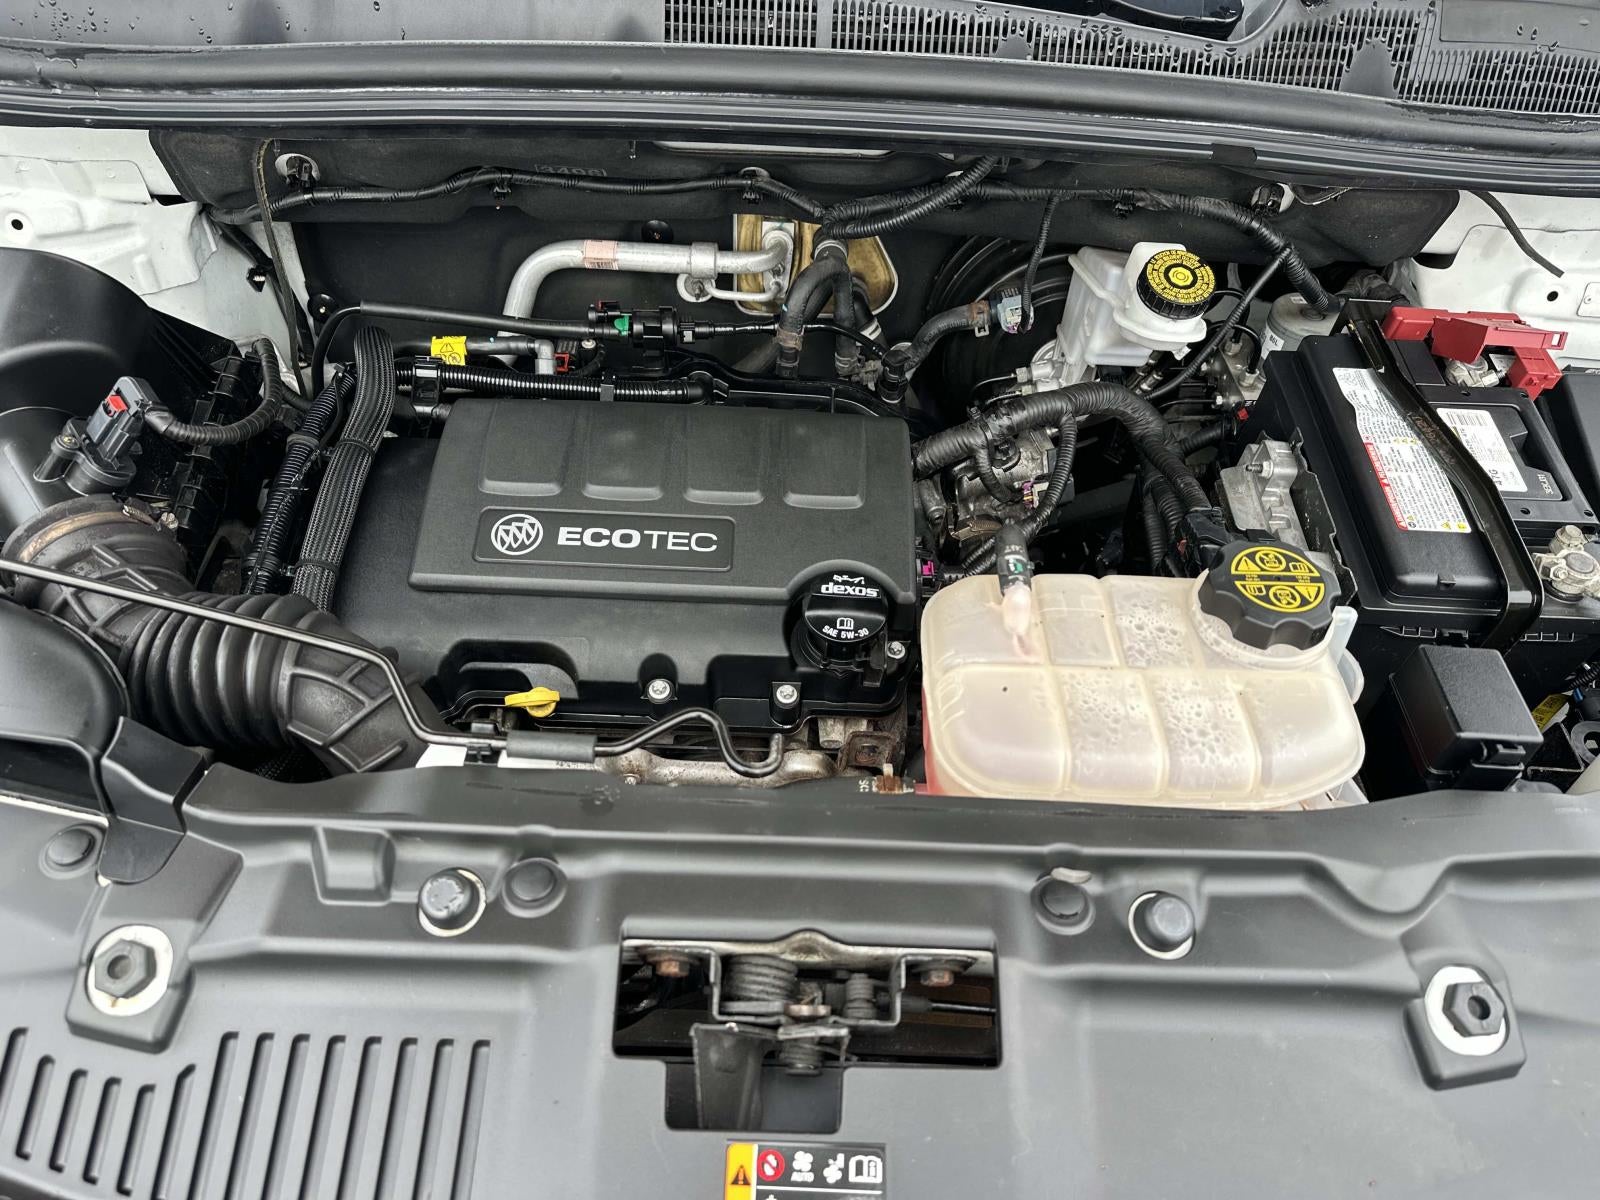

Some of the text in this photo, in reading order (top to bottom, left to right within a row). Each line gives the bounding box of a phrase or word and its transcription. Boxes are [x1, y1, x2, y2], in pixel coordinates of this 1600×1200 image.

[557, 526, 718, 552] ECOTEC
[820, 582, 880, 597] dexos
[822, 625, 870, 639] SAE 5W-30
[790, 1171, 815, 1183] AUTO
